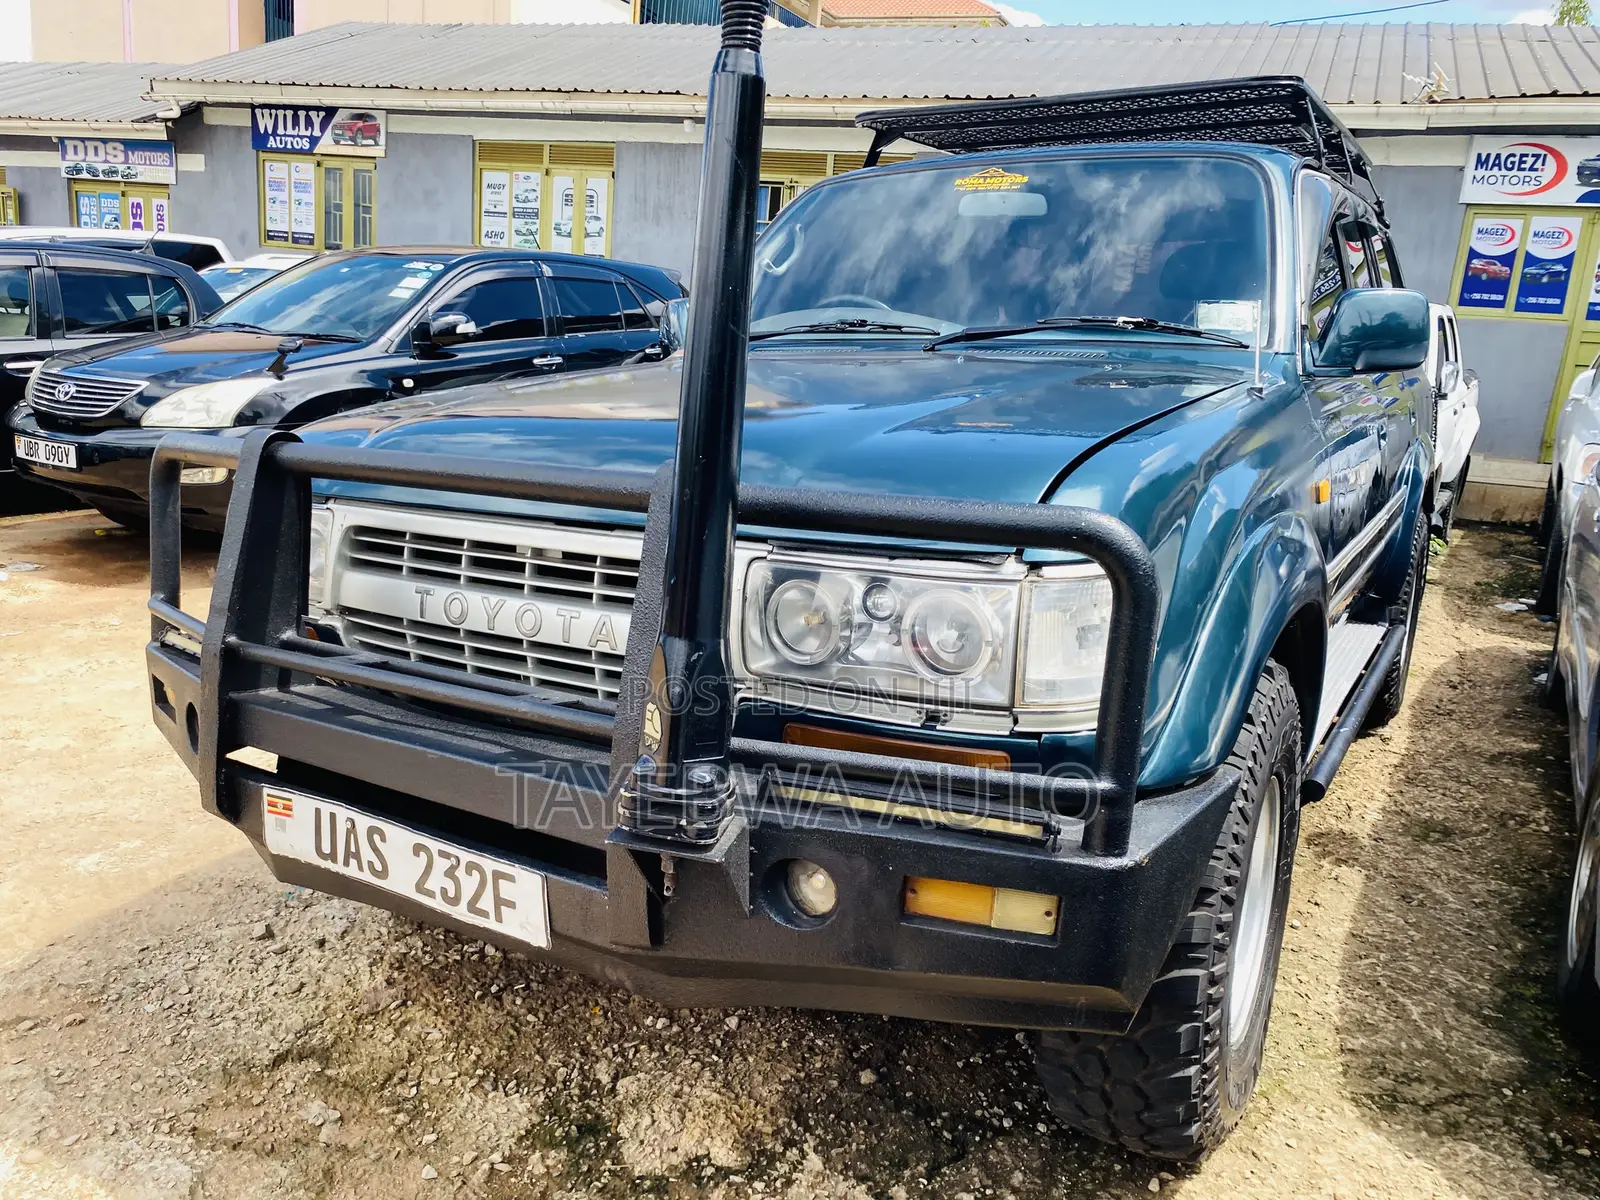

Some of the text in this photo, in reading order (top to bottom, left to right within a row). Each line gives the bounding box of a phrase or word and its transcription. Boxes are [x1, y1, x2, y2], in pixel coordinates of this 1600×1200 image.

[255, 108, 326, 136] WILLY
[267, 136, 310, 149] AUTOS
[64, 140, 170, 166] DDS MOTORS
[954, 175, 1029, 186] ROMA MOTORS
[1471, 174, 1543, 187] MOTORS
[101, 198, 120, 207] DDS
[484, 230, 505, 240] ASHO
[23, 440, 40, 460] UBR
[45, 443, 70, 465] 090Y
[414, 586, 618, 650] TOYOTA
[314, 807, 516, 924] UAS 232F
